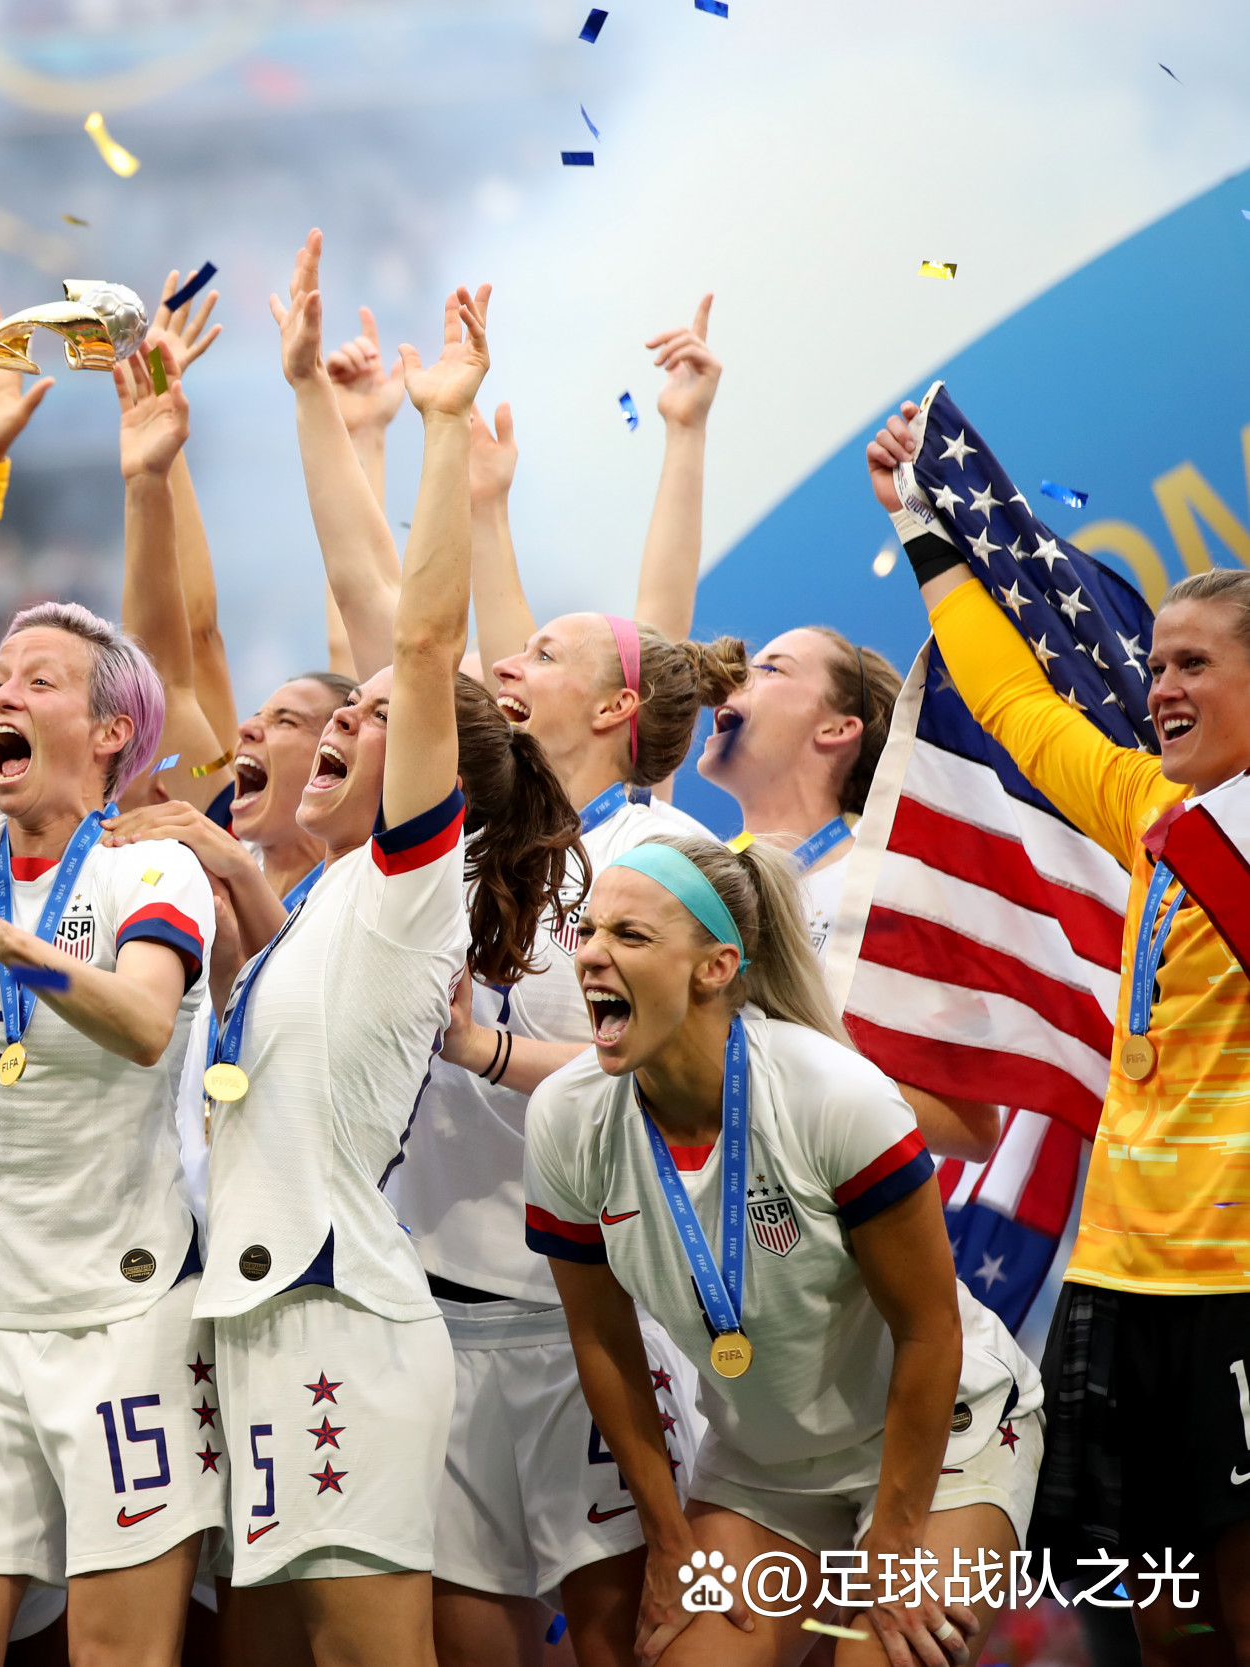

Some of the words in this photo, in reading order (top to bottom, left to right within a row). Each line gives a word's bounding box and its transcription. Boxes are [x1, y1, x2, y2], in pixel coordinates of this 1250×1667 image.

[66, 857, 78, 875] FIFA
[54, 884, 66, 903] FIFA
[44, 911, 56, 931] FIFA
[732, 1042, 740, 1063] FIFA
[1126, 1054, 1147, 1064] FIFA
[1, 1057, 19, 1073] FIFA
[211, 1075, 241, 1089] FIFA
[731, 1107, 739, 1128] FIFA
[731, 1139, 739, 1160] FIFA
[730, 1172, 738, 1194] FIFA
[654, 1135, 666, 1156] FIFA
[663, 1166, 677, 1185] FIFA
[673, 1194, 687, 1215] FIFA
[684, 1224, 698, 1244] FIFA
[696, 1253, 710, 1273] FIFA
[707, 1283, 721, 1304] FIFA
[729, 1204, 738, 1226] FIFA
[751, 1202, 790, 1225] USA
[729, 1237, 737, 1259] FIFA
[728, 1270, 737, 1291] FIFA
[717, 1348, 745, 1362] FIFA
[96, 1393, 171, 1494] 15
[250, 1424, 275, 1517] 5
